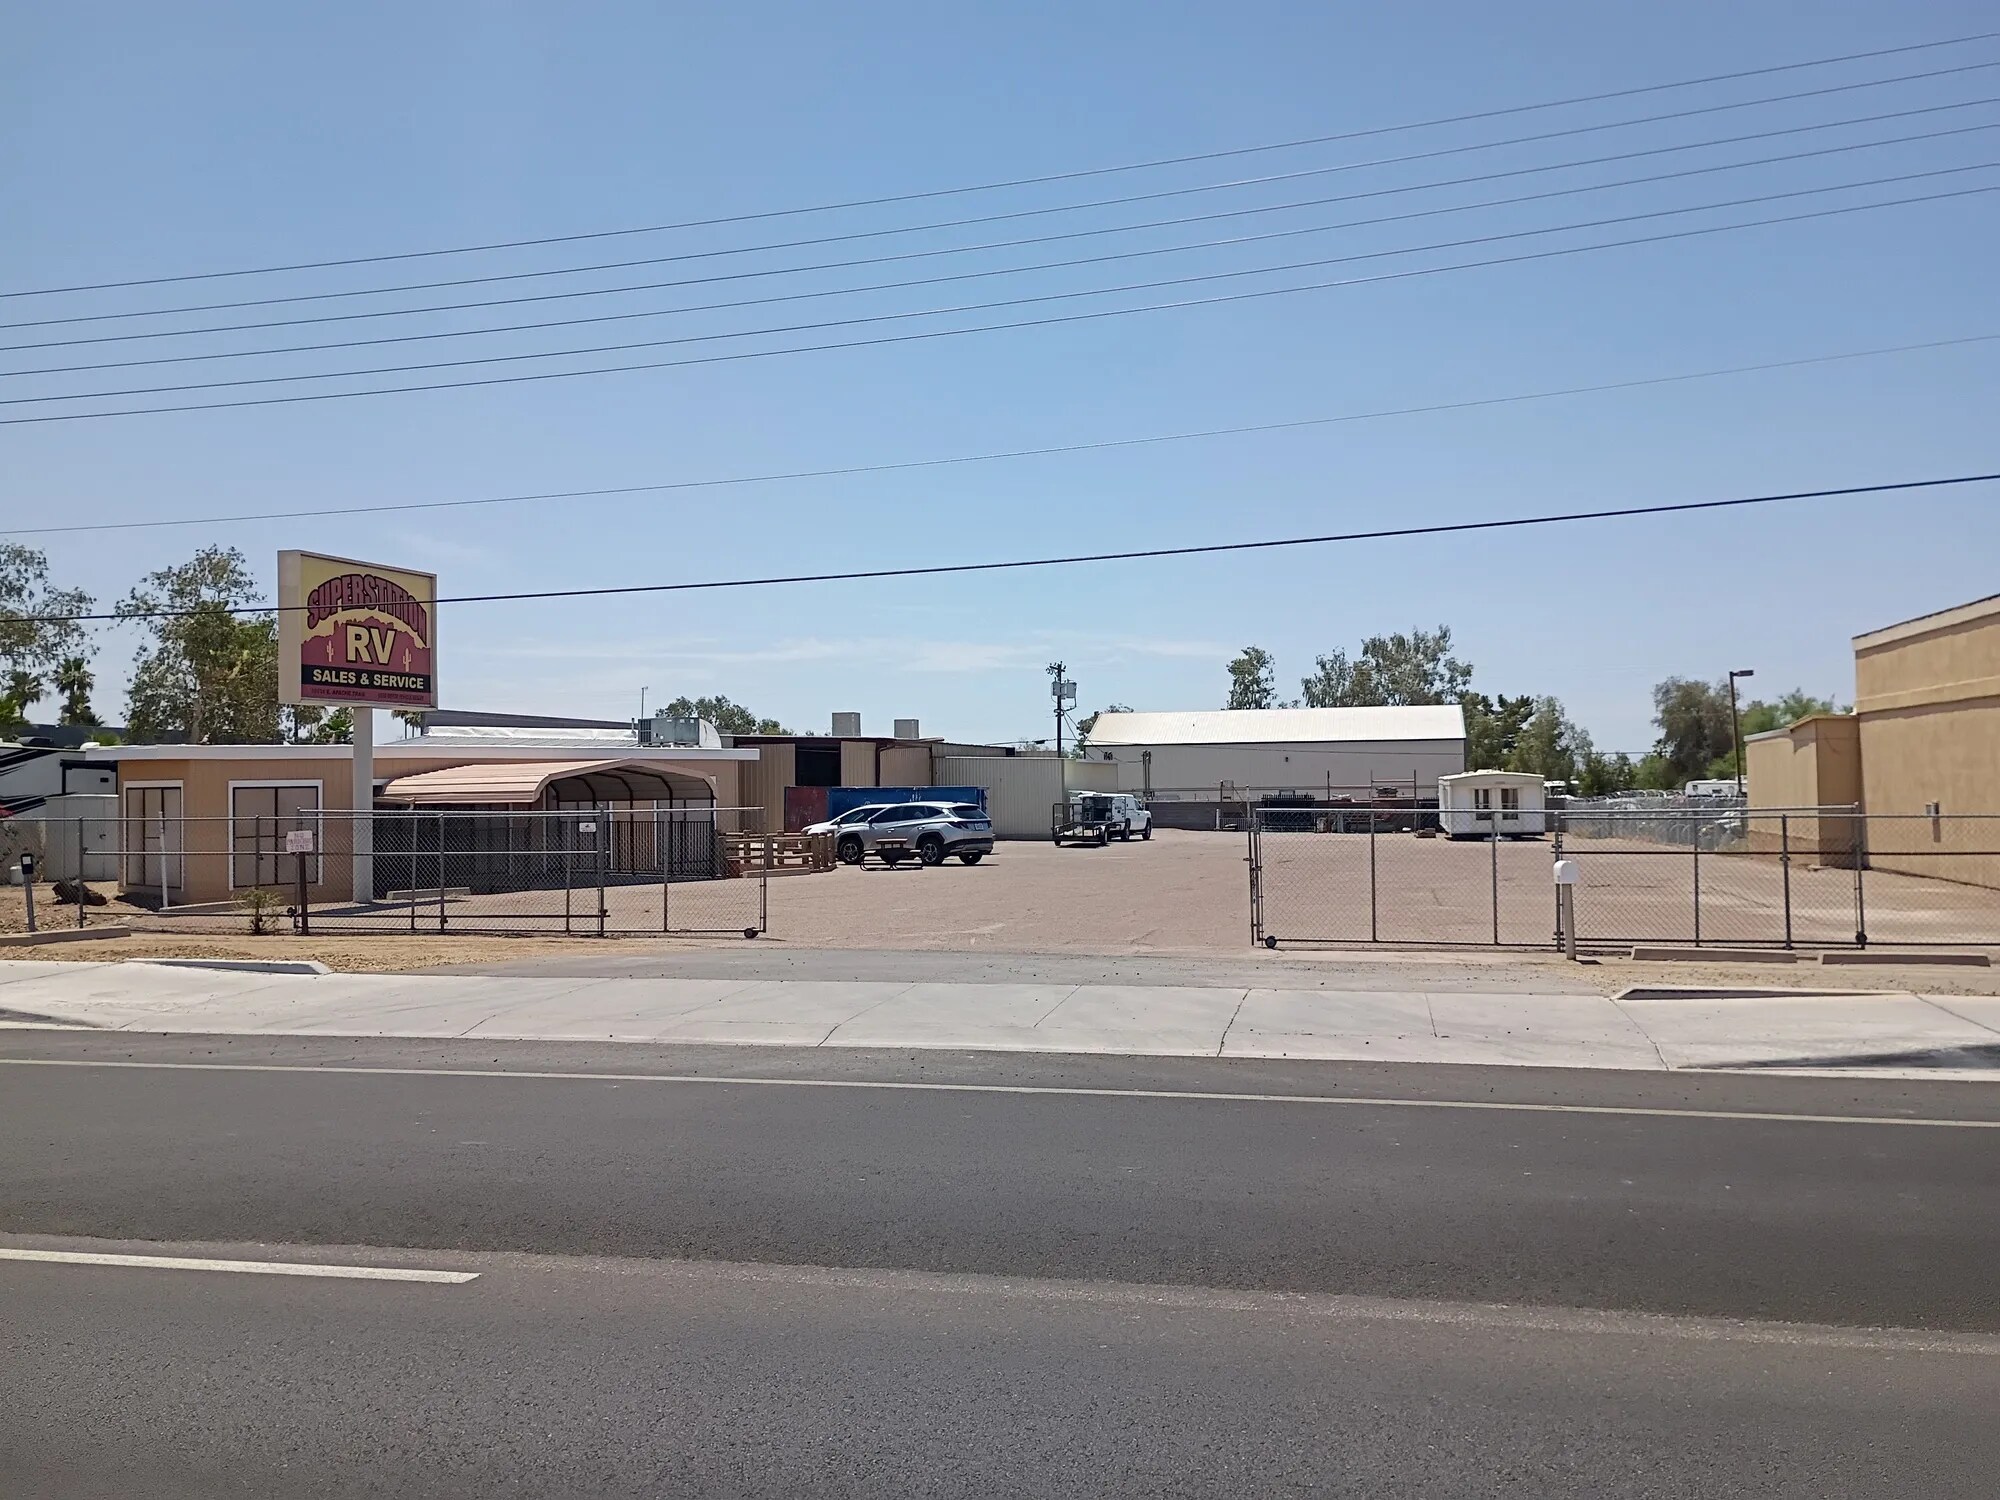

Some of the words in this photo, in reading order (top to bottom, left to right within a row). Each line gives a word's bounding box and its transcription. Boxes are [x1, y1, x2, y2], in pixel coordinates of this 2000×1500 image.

[307, 574, 427, 647] SUPERSTITION
[346, 623, 397, 665] RV
[313, 669, 356, 684] SALES
[360, 673, 369, 685] &
[373, 674, 424, 689] SERVICE
